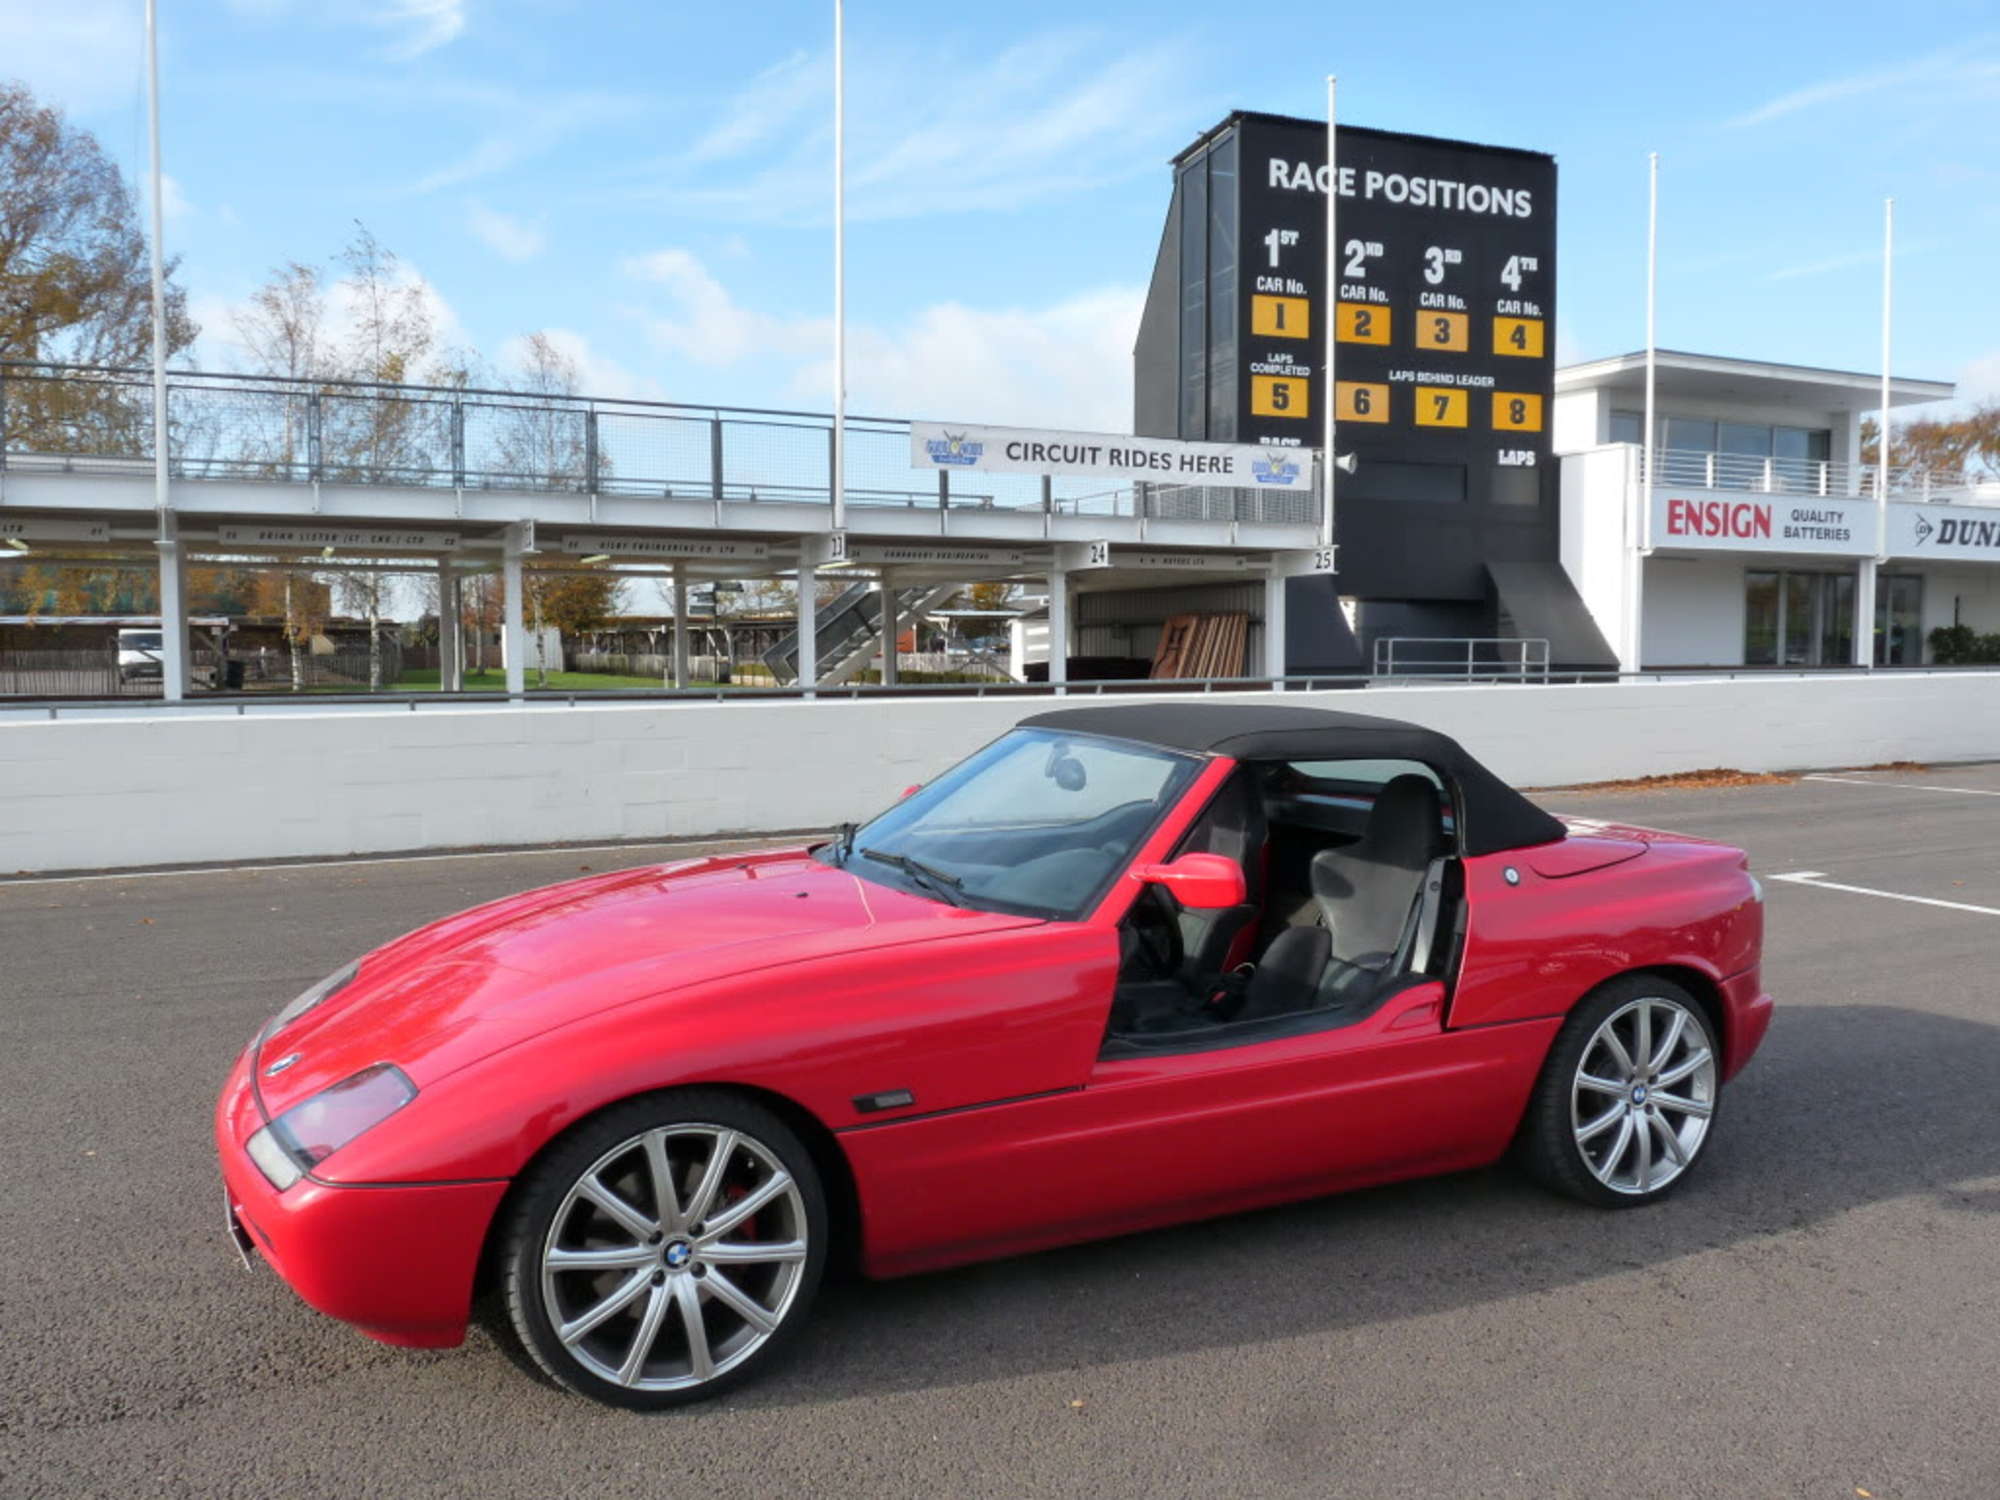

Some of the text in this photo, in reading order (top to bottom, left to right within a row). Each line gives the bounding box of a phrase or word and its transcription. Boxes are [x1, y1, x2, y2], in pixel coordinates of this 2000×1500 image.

[1269, 157, 1532, 218] RACE POSITIONS
[1264, 228, 1299, 268] 1ST
[1257, 276, 1308, 294] CAR No.
[1340, 284, 1389, 302] CAR No.
[1420, 292, 1467, 310] CAR No.
[1497, 299, 1542, 316] CAR No.
[1354, 310, 1372, 337] 2
[1434, 317, 1450, 344] 3
[1510, 324, 1526, 351] 4
[1267, 353, 1294, 364] LAPS
[1250, 363, 1311, 377] COMPLETED
[1389, 370, 1496, 387] LAPS BEHIND LEADER
[1272, 383, 1289, 411] 5
[1354, 388, 1371, 415] 6
[1434, 395, 1450, 421] 7
[1510, 398, 1526, 425] 8
[1005, 441, 1102, 466] CIRCUIT
[1109, 447, 1172, 471] RIDES
[1179, 454, 1235, 474] HERE
[1498, 449, 1536, 466] LAPS
[1667, 499, 1772, 540] ENSIGN
[1790, 508, 1845, 525] QUALITY
[1783, 525, 1851, 542] BATTERIES
[1091, 544, 1105, 564] 24
[1315, 551, 1331, 570] 25
